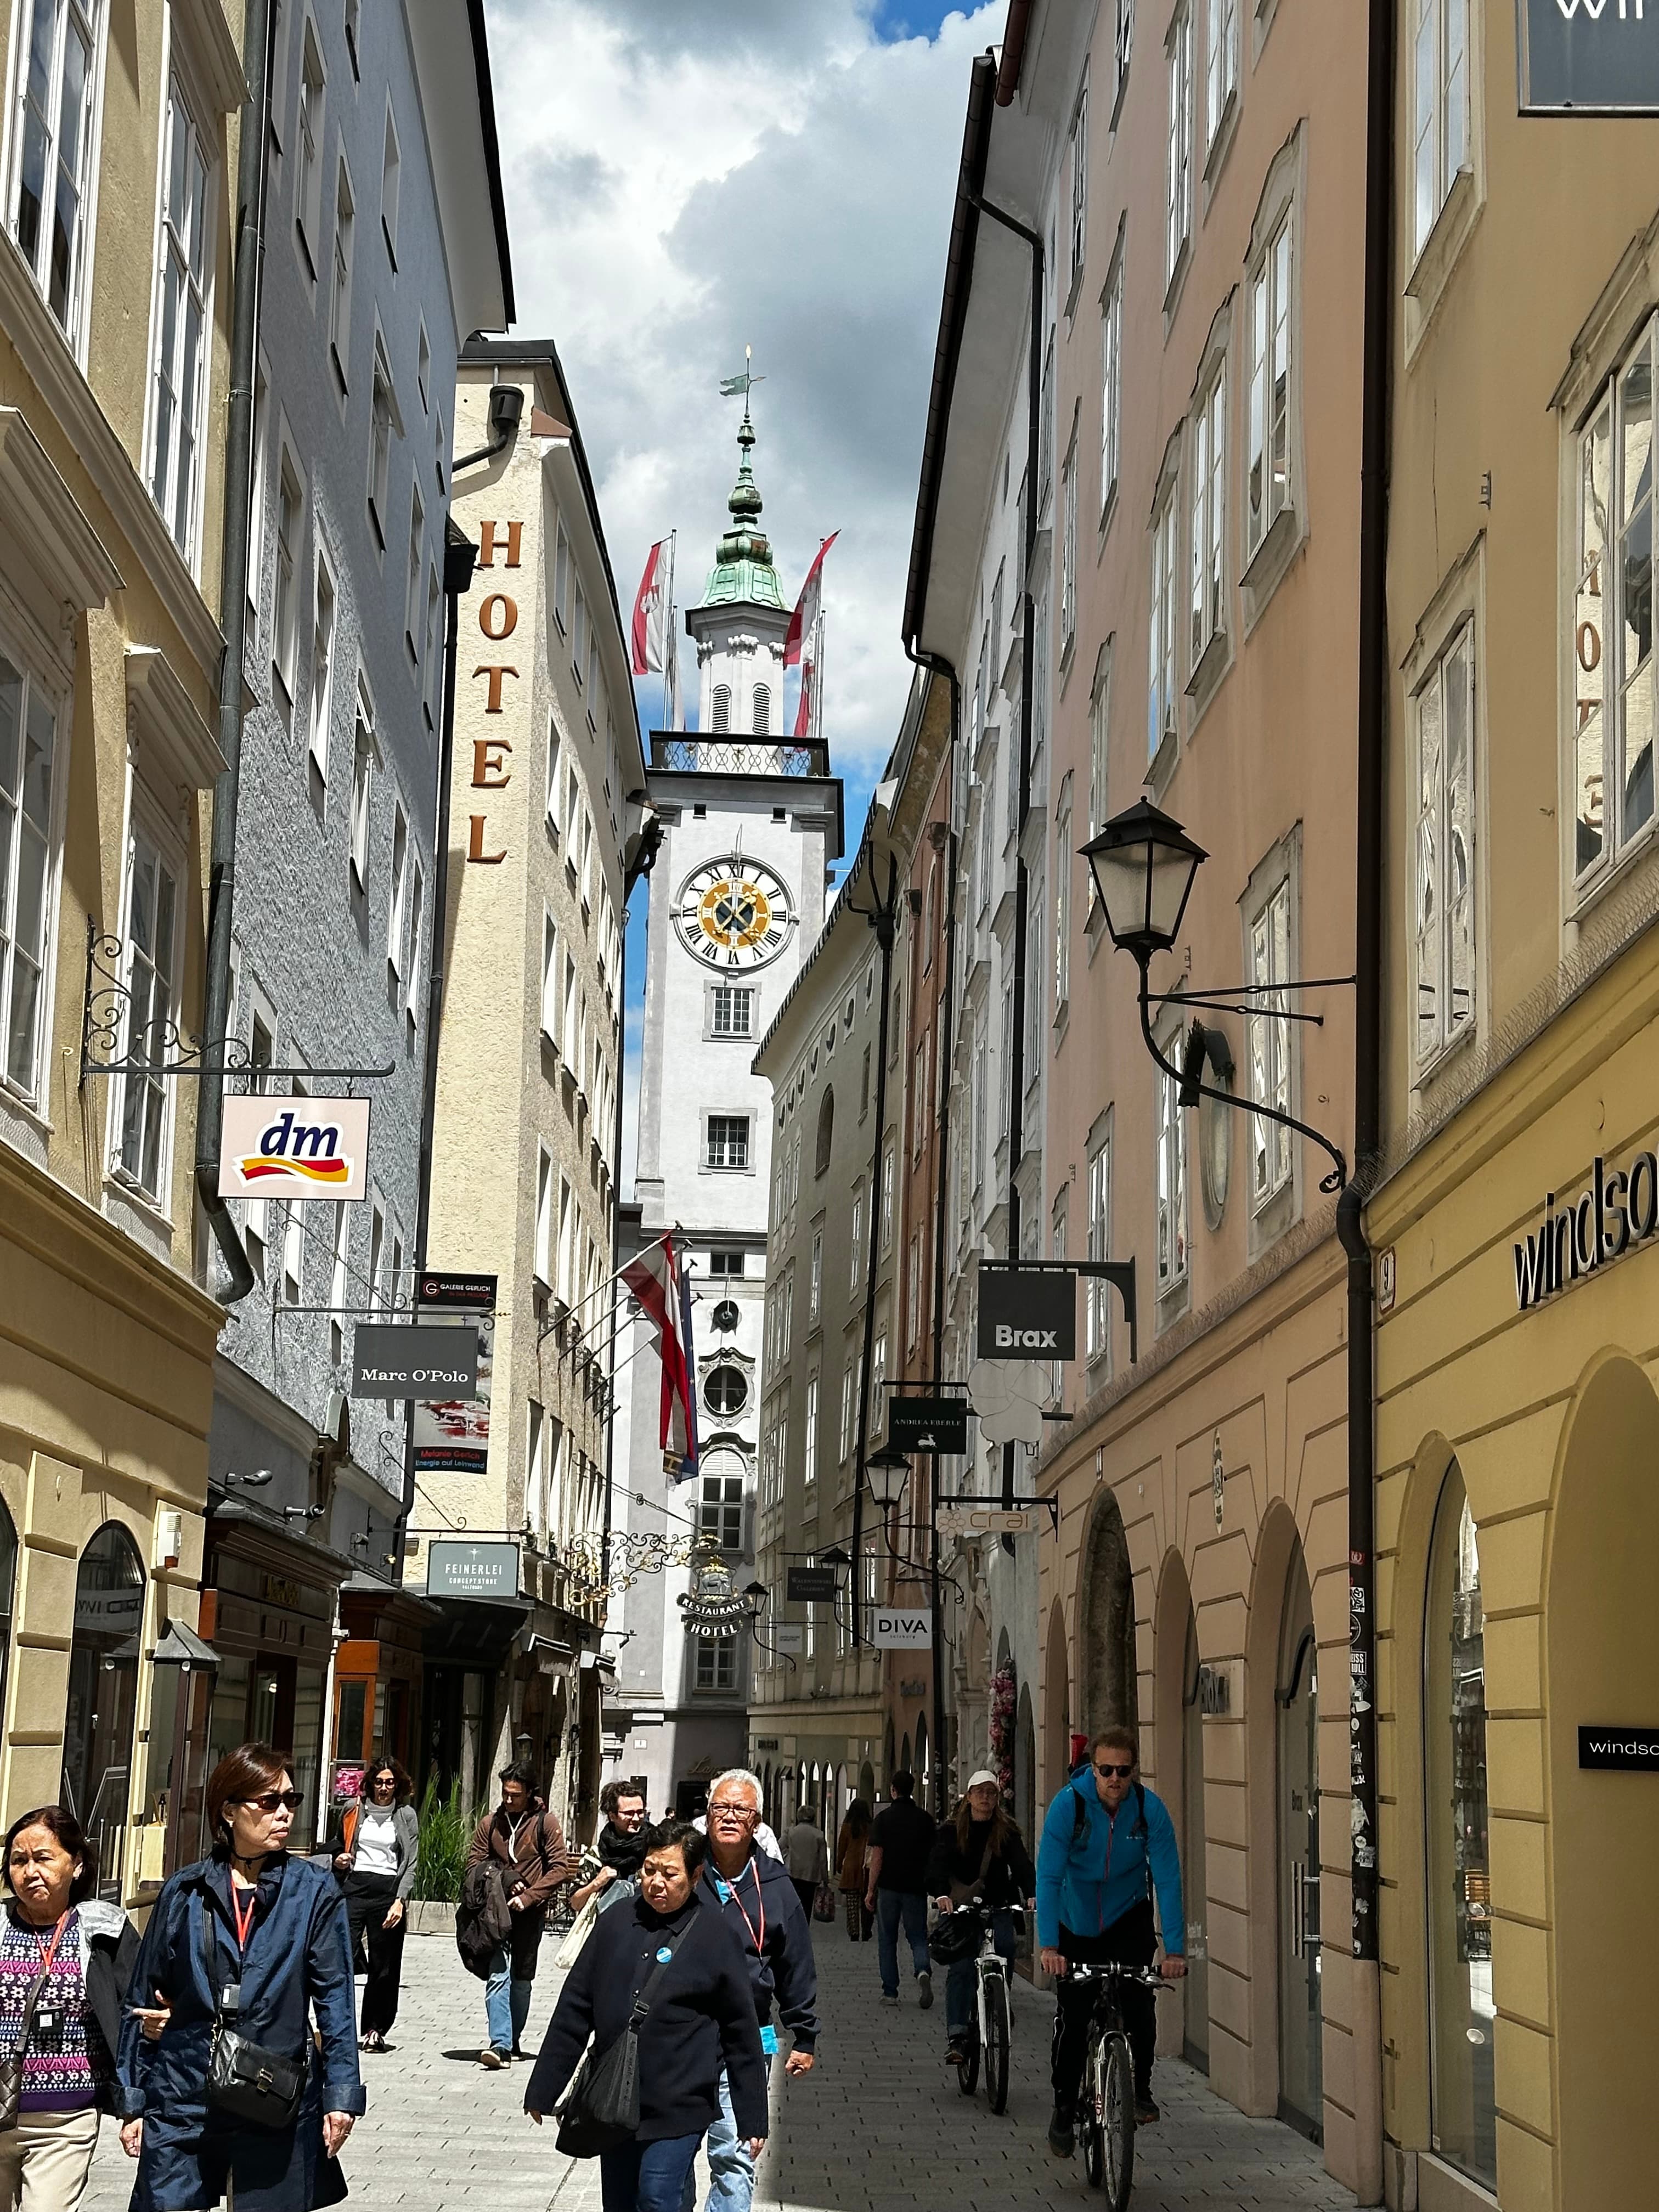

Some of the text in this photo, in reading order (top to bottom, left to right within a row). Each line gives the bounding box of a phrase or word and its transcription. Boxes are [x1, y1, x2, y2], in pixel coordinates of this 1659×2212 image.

[467, 521, 524, 864] HOTEL
[260, 1112, 338, 1157] dm
[1513, 1143, 1659, 1311] windso
[1383, 1256, 1389, 1290] 9
[995, 1324, 1057, 1348] Brax
[361, 1369, 469, 1383] Marc O'Polo
[894, 1418, 928, 1426] ANDREA
[970, 1513, 1028, 1528] crai
[445, 1564, 502, 1576] FEINERLEI
[682, 1598, 745, 1616] RESTAURANT
[690, 1624, 737, 1637] HOTEL
[878, 1620, 928, 1633] DIVA
